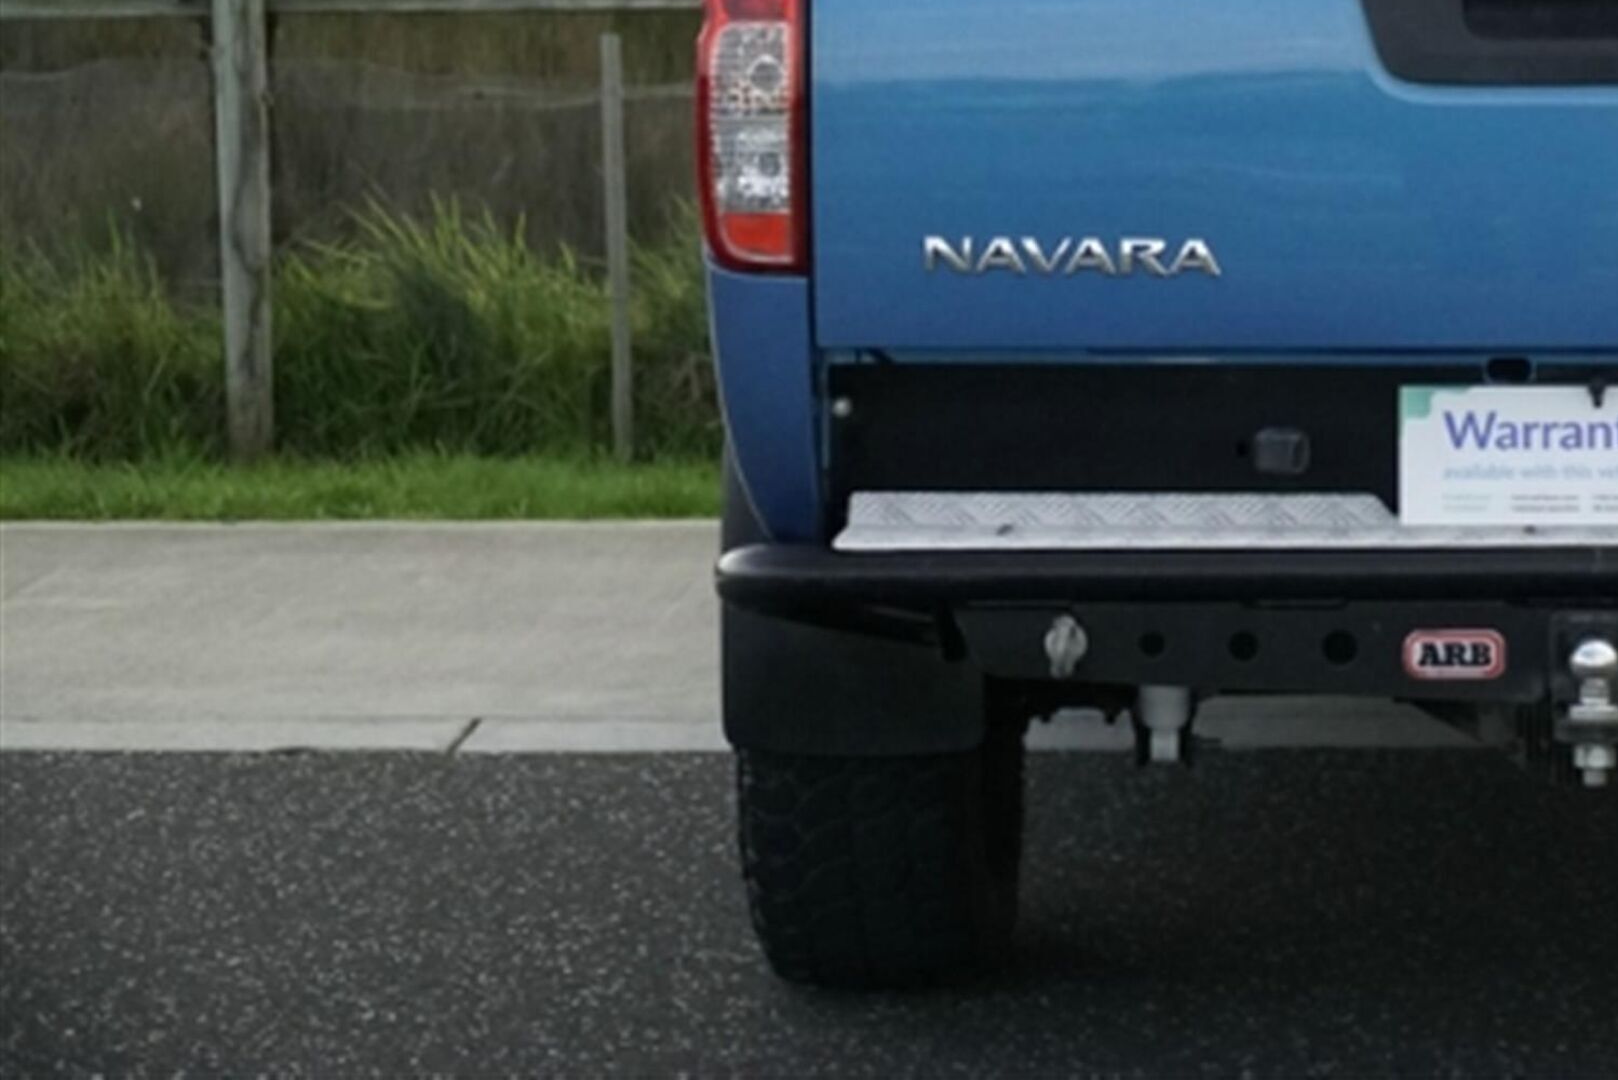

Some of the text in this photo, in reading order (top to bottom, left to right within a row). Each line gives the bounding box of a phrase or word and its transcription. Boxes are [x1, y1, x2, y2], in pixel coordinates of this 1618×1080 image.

[922, 235, 1222, 276] NAVARA
[1443, 463, 1515, 480] available
[1520, 463, 1557, 480] with
[1418, 641, 1492, 667] ARB
